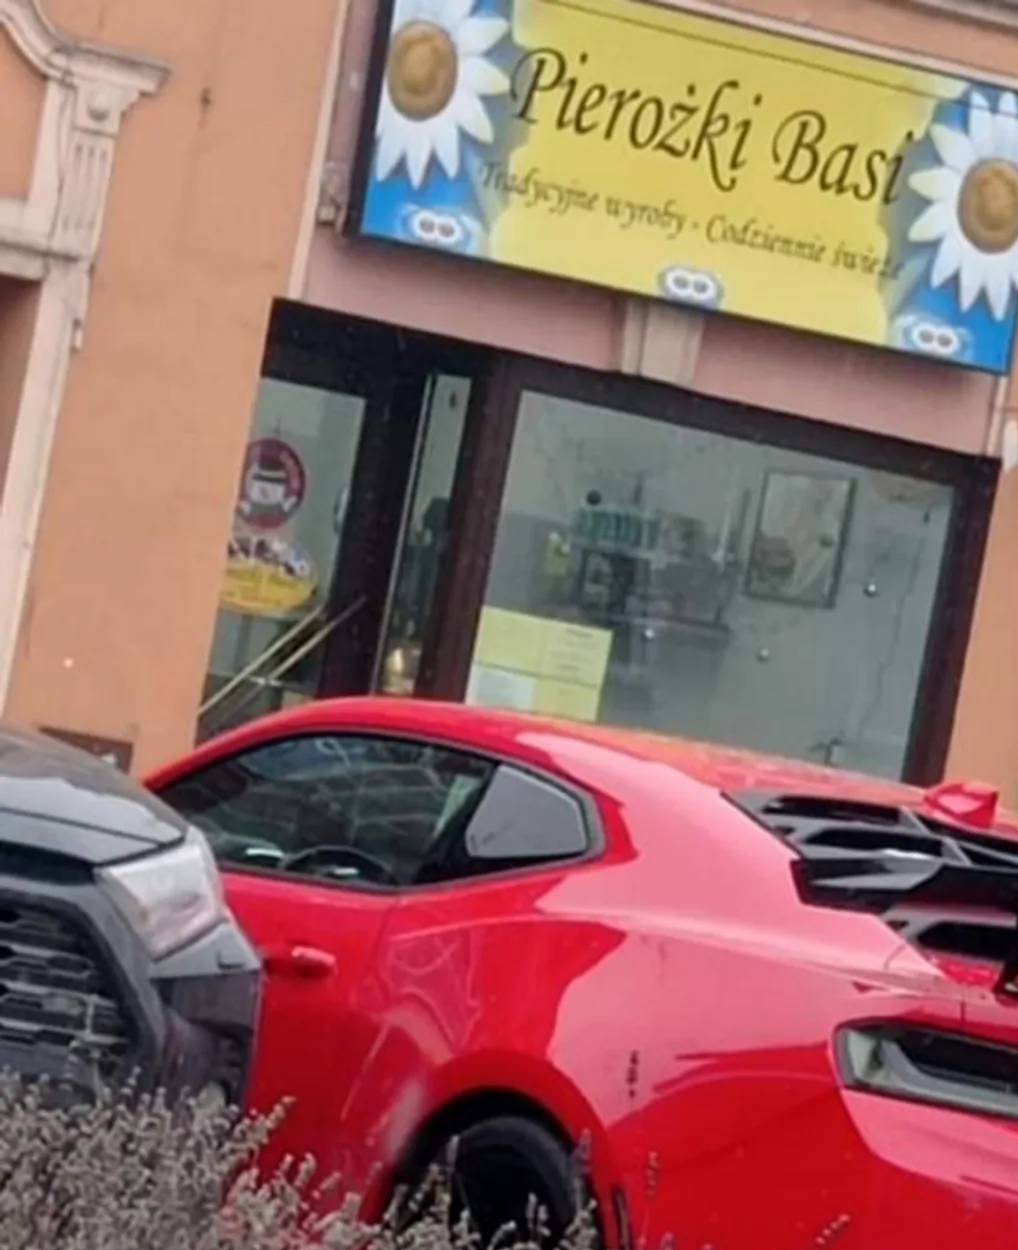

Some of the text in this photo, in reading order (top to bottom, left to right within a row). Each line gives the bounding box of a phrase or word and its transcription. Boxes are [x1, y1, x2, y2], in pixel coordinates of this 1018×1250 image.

[509, 47, 915, 205] Pierożki Basi
[479, 161, 600, 216] Tradycyjne
[605, 197, 688, 241] wyroby
[706, 213, 827, 263] Codziennie
